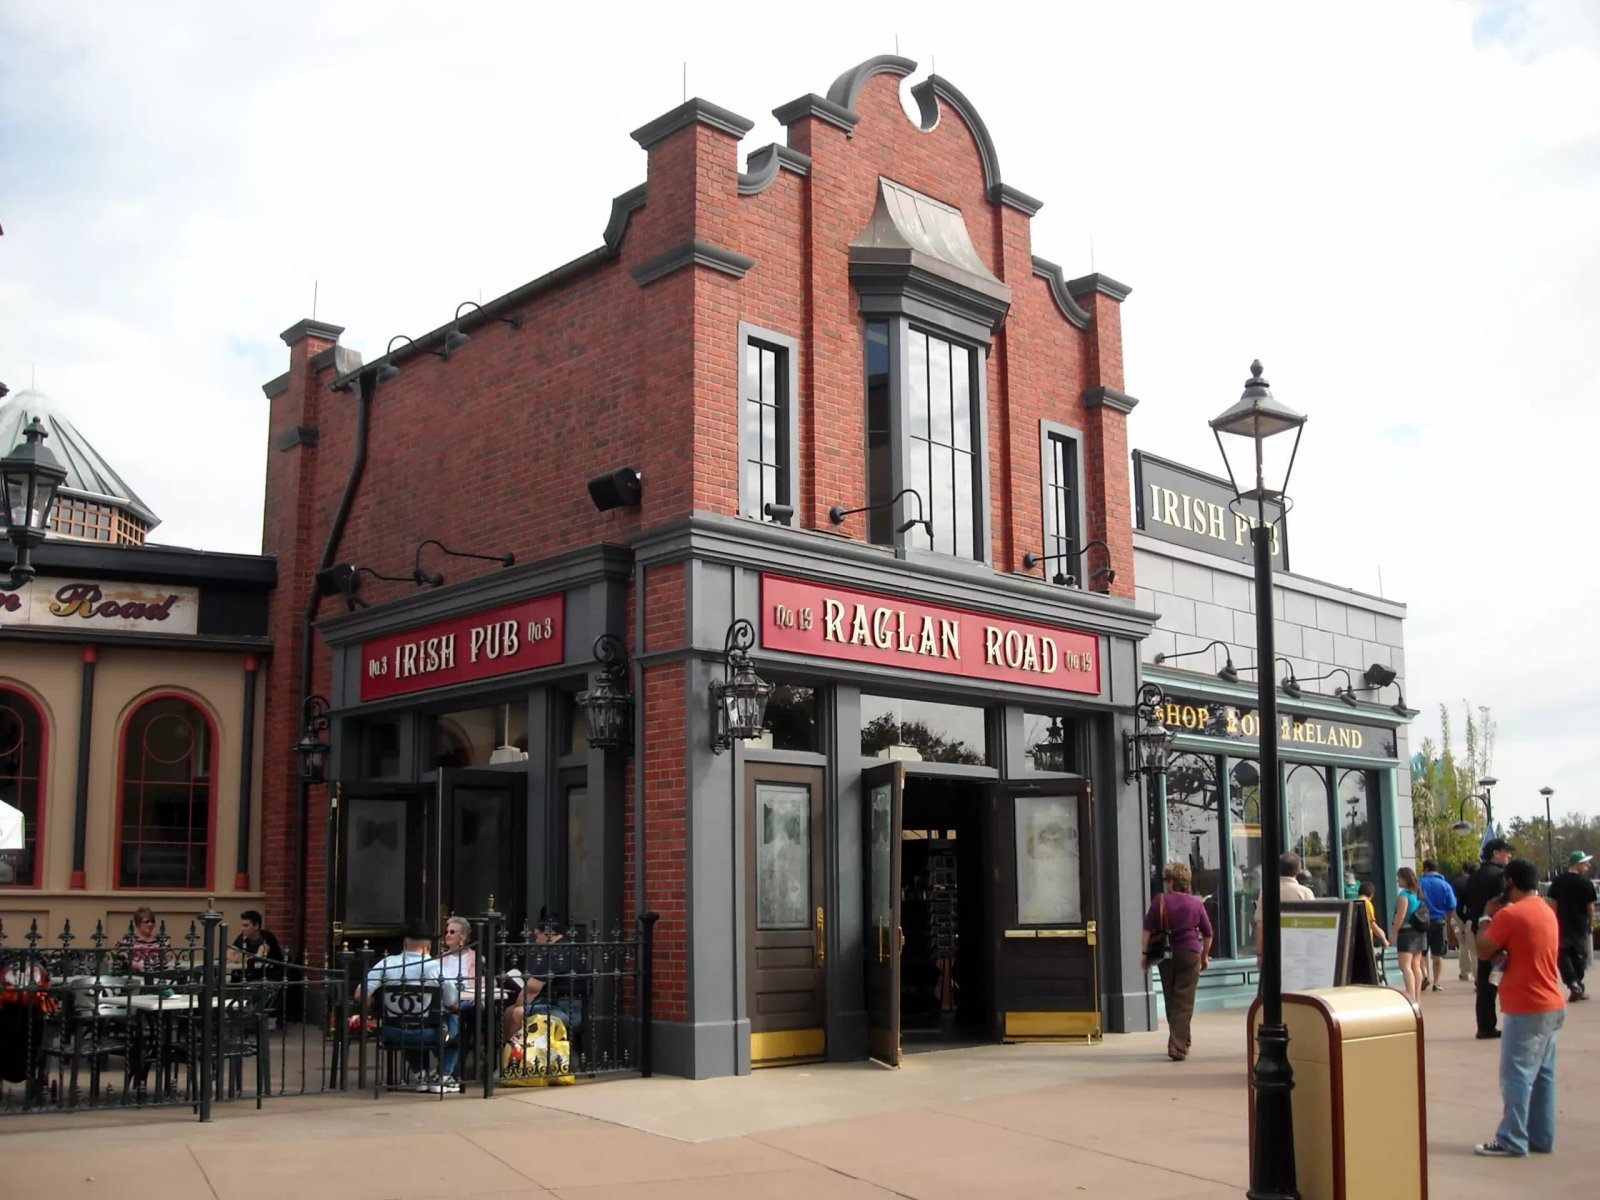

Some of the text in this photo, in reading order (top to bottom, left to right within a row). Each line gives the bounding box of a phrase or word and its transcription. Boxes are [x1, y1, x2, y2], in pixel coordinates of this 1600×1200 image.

[1150, 485, 1227, 542] IRISH
[49, 583, 179, 621] Road
[395, 633, 456, 679] IRISH
[470, 619, 520, 663] PUB
[798, 608, 814, 630] 19
[824, 598, 961, 661] RAGLAN
[985, 626, 1059, 674] ROAD
[1081, 652, 1093, 674] 19
[1226, 708, 1259, 736] FO
[1281, 720, 1363, 749] IRELAND
